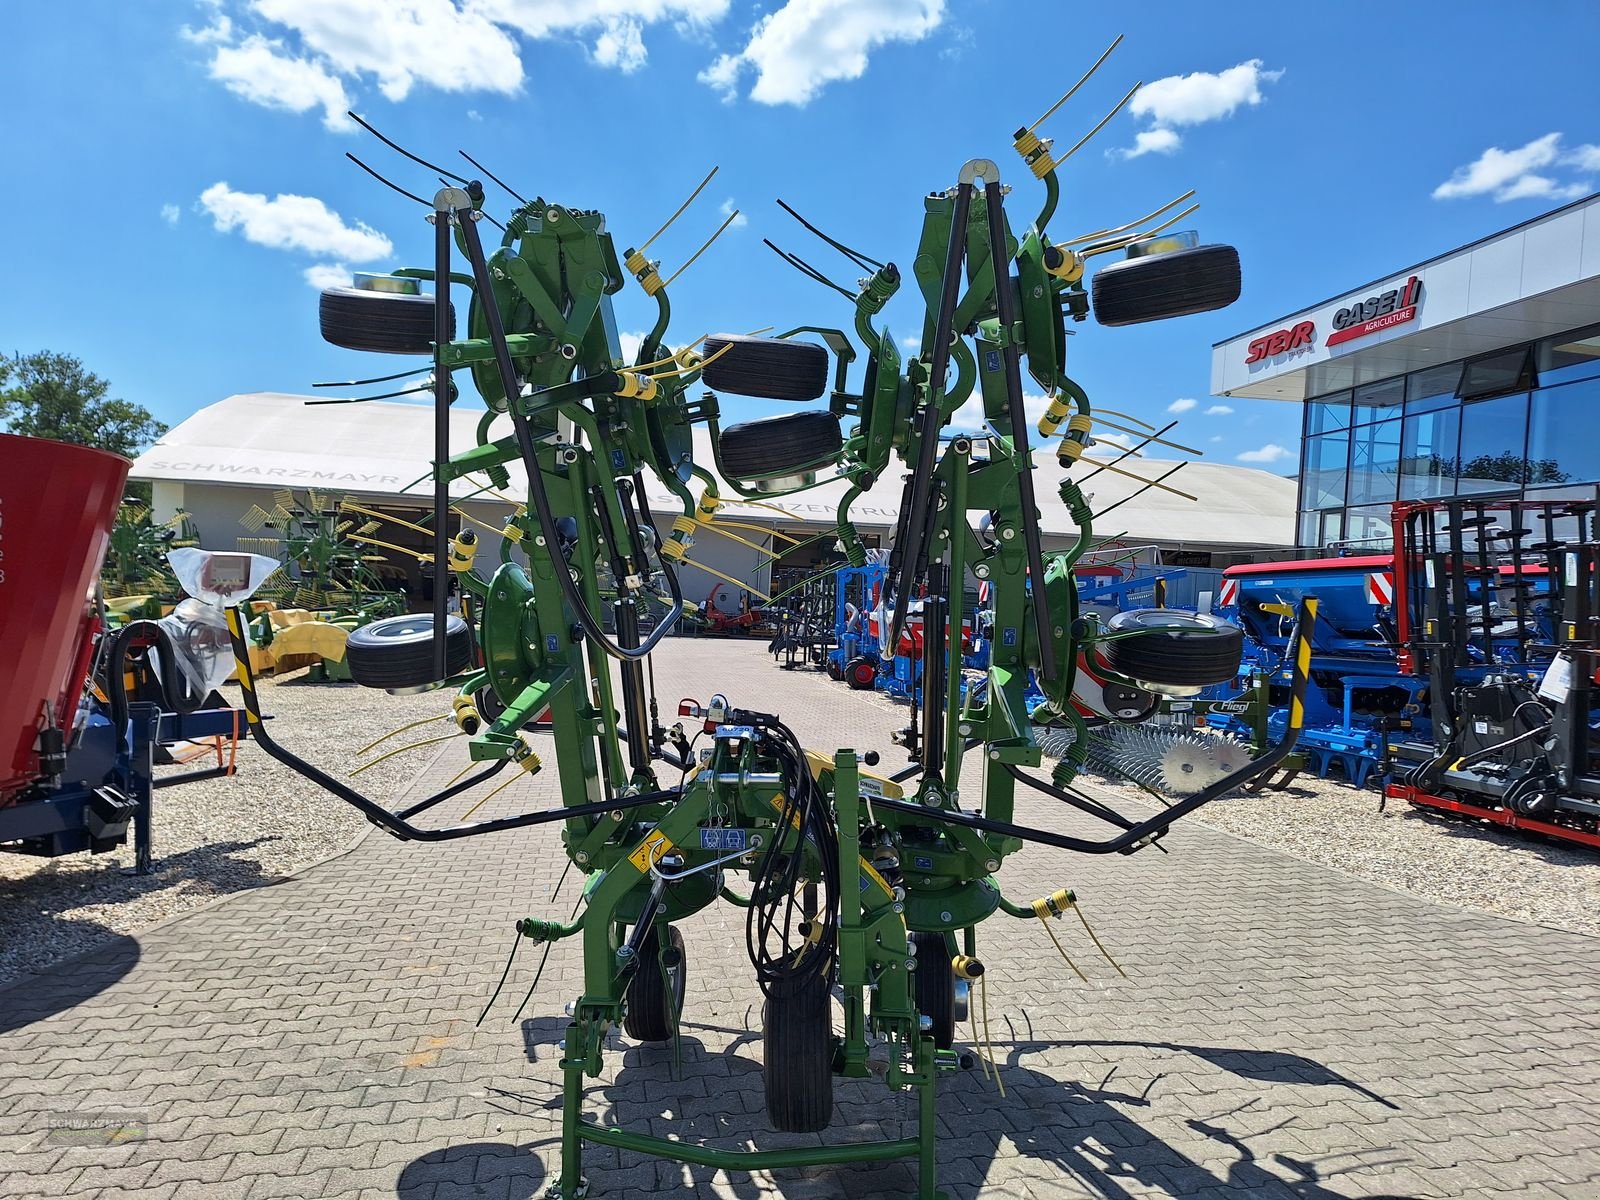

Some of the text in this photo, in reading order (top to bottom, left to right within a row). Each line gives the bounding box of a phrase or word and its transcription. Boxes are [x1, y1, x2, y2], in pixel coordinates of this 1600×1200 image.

[1364, 310, 1410, 331] AGRICULTURE
[1245, 321, 1315, 364] STEYR
[149, 461, 398, 485] SCHWARZMAYR
[1221, 701, 1249, 712] Fliegl
